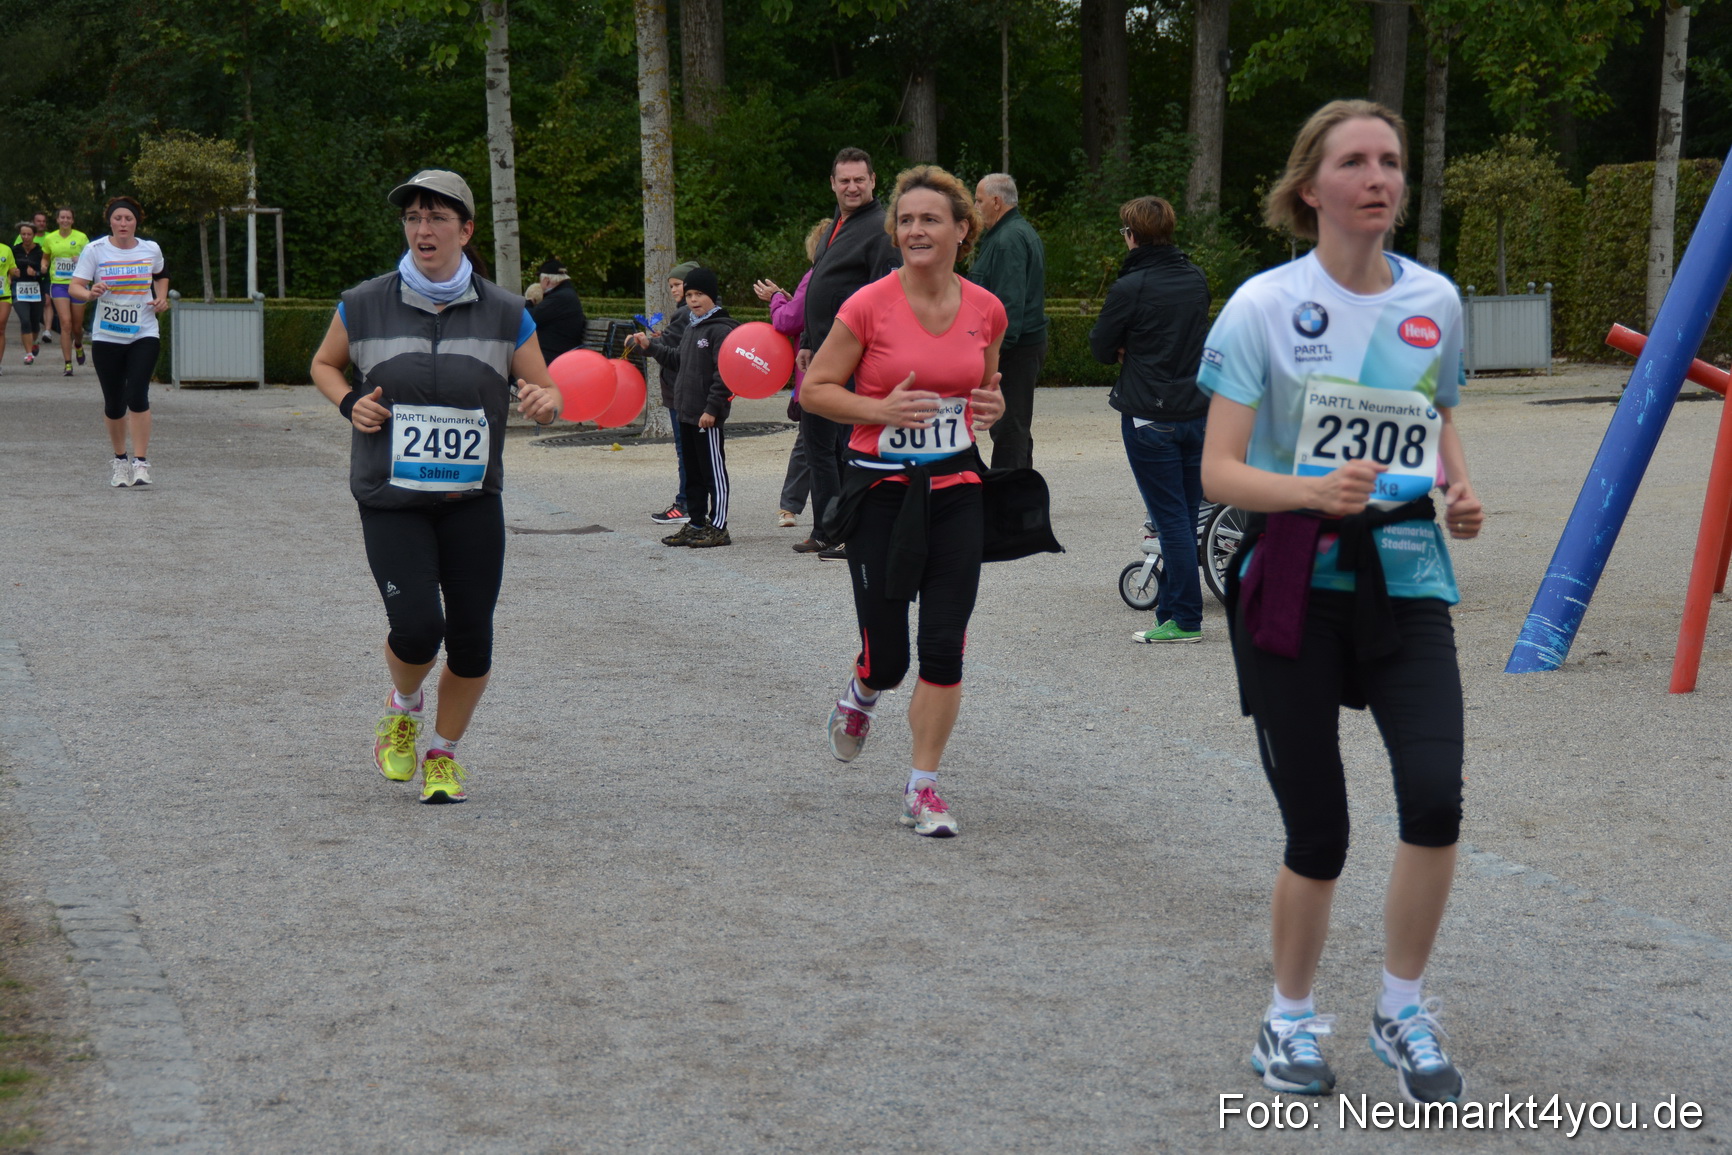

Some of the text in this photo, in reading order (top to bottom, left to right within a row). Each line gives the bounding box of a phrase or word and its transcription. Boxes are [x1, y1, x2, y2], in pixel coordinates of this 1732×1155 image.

[126, 266, 137, 275] BEI
[138, 265, 149, 274] MIR
[19, 286, 39, 295] 2415
[104, 306, 138, 324] 2300
[1294, 344, 1332, 356] PARTL
[1294, 354, 1333, 363] Neumarkt
[1309, 393, 1421, 418] PARTL Neumarkt
[395, 413, 475, 425] PARTL Neumarkt
[889, 418, 958, 449] 3017
[1312, 414, 1428, 469] 2308
[403, 426, 482, 461] 2492
[419, 466, 460, 480] Sabine
[1374, 478, 1399, 497] ke
[1381, 537, 1427, 554] Stadtlauf
